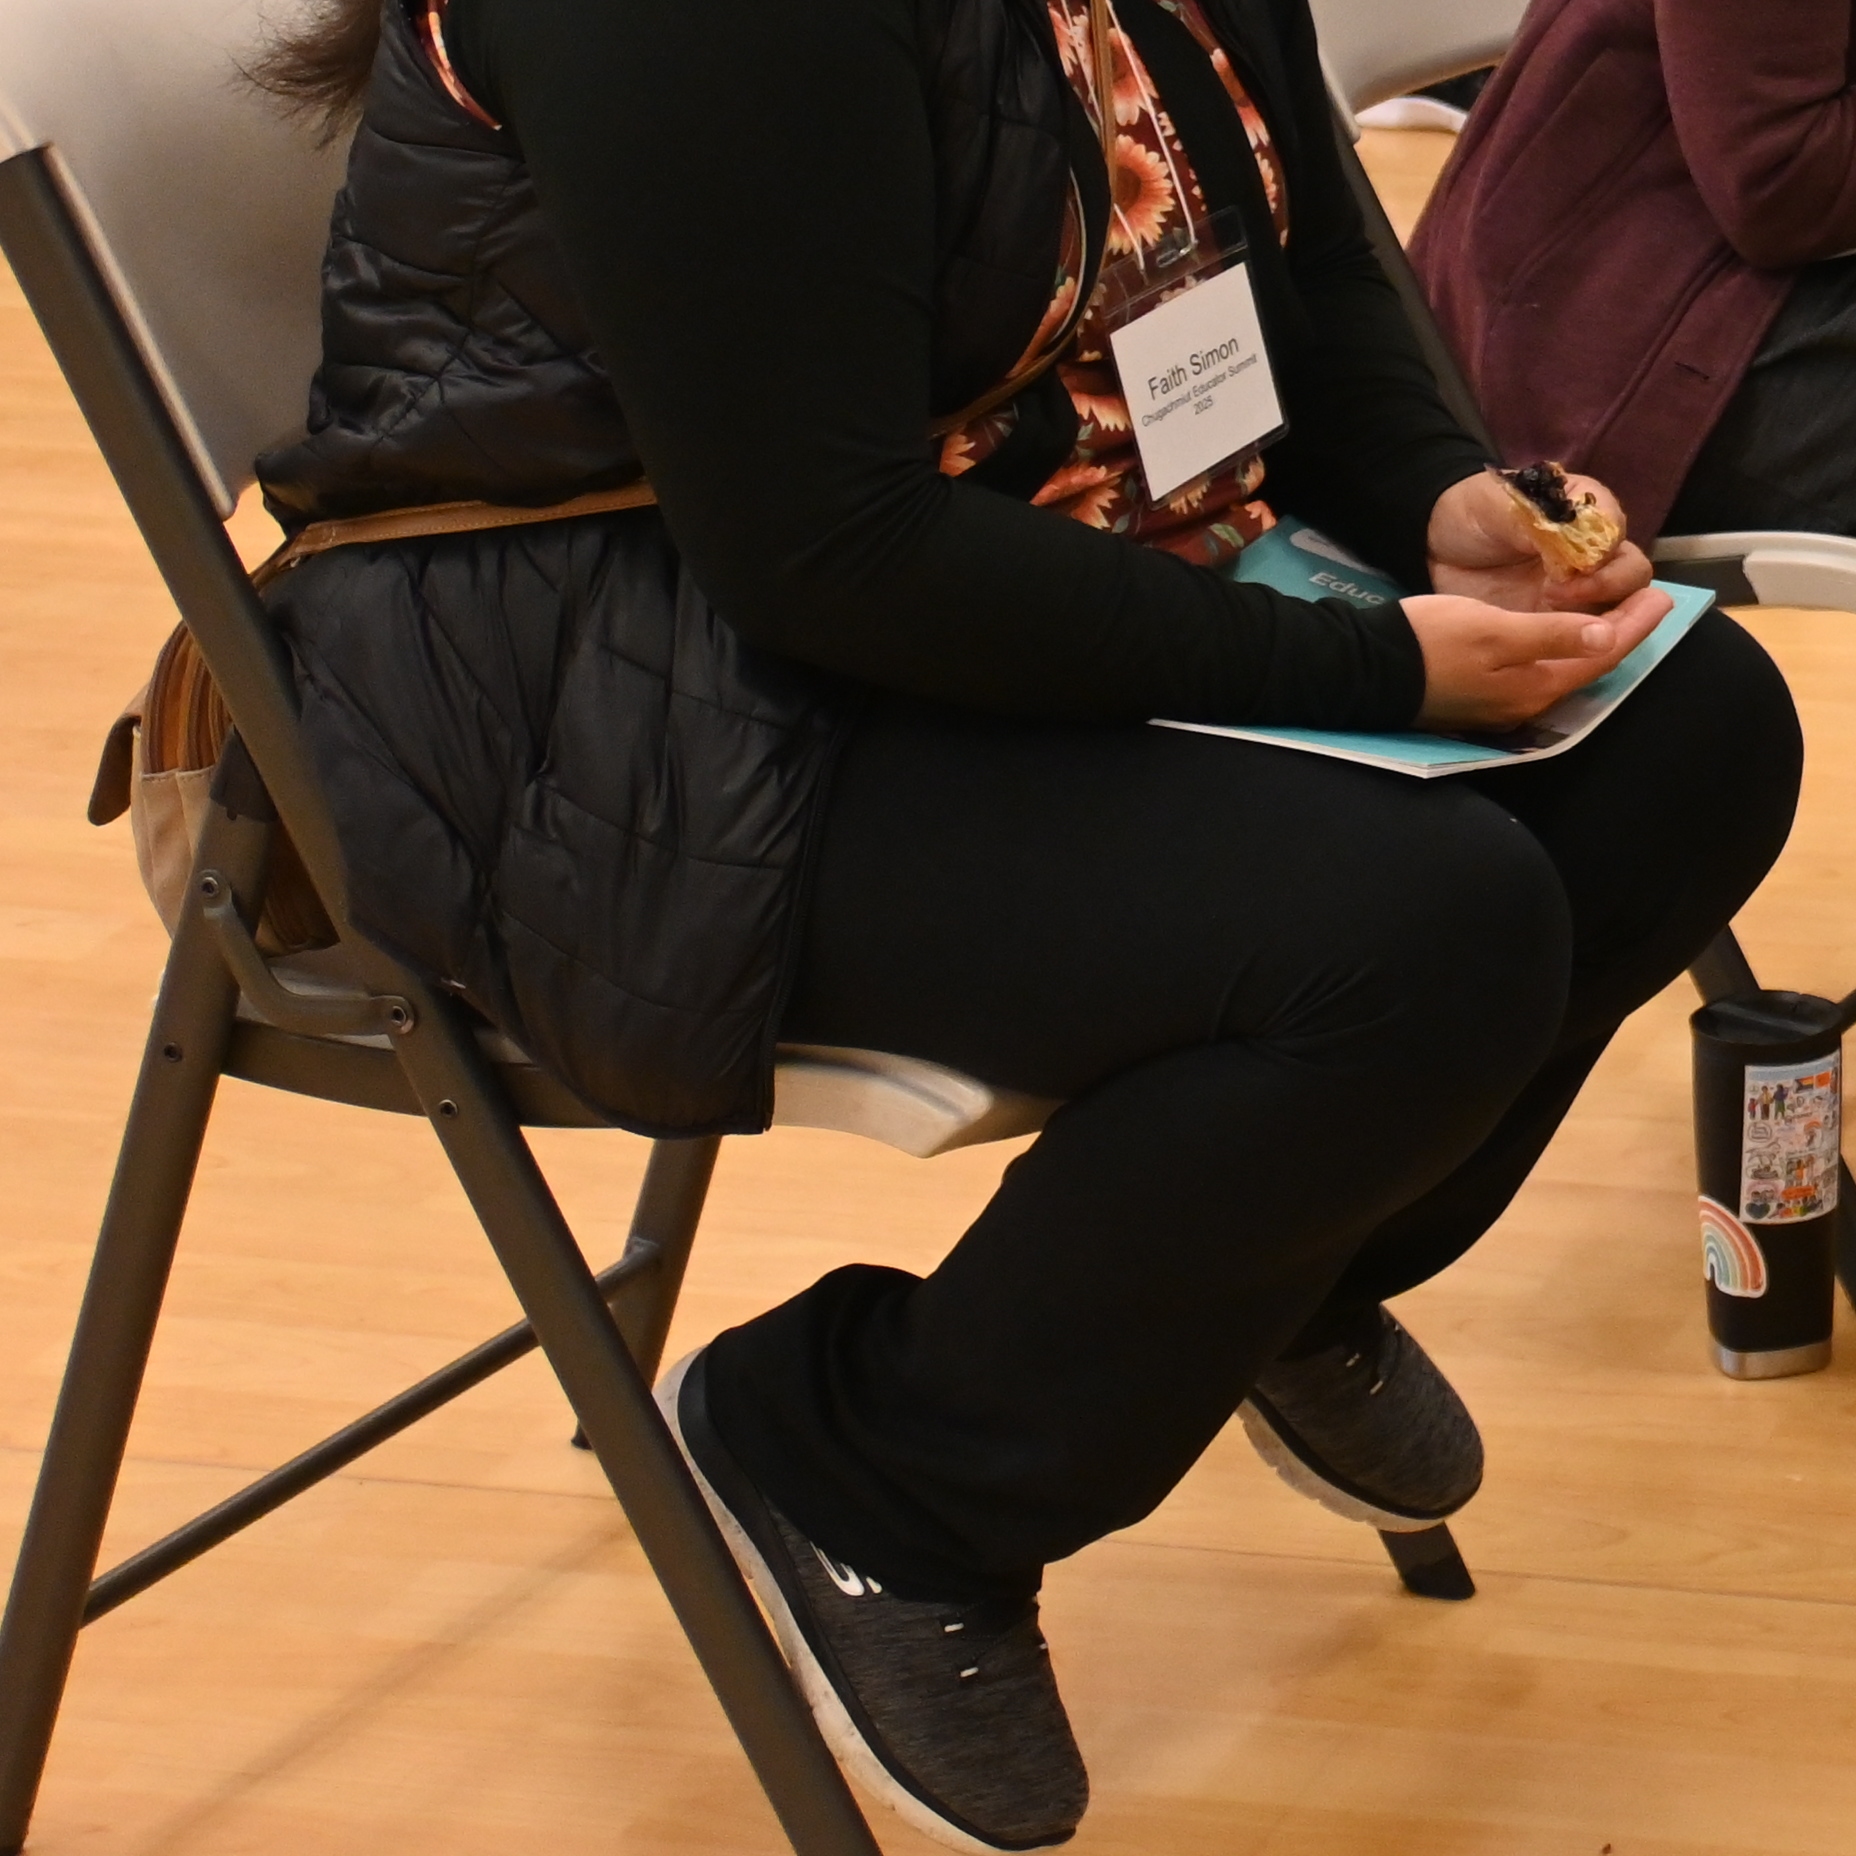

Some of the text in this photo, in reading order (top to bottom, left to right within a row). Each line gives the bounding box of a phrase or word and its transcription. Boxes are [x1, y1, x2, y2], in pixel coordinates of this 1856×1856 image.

[1147, 338, 1239, 401] Faith Simon
[1192, 371, 1227, 398] Educator
[1227, 353, 1258, 377] Summit
[1193, 395, 1214, 416] 2025
